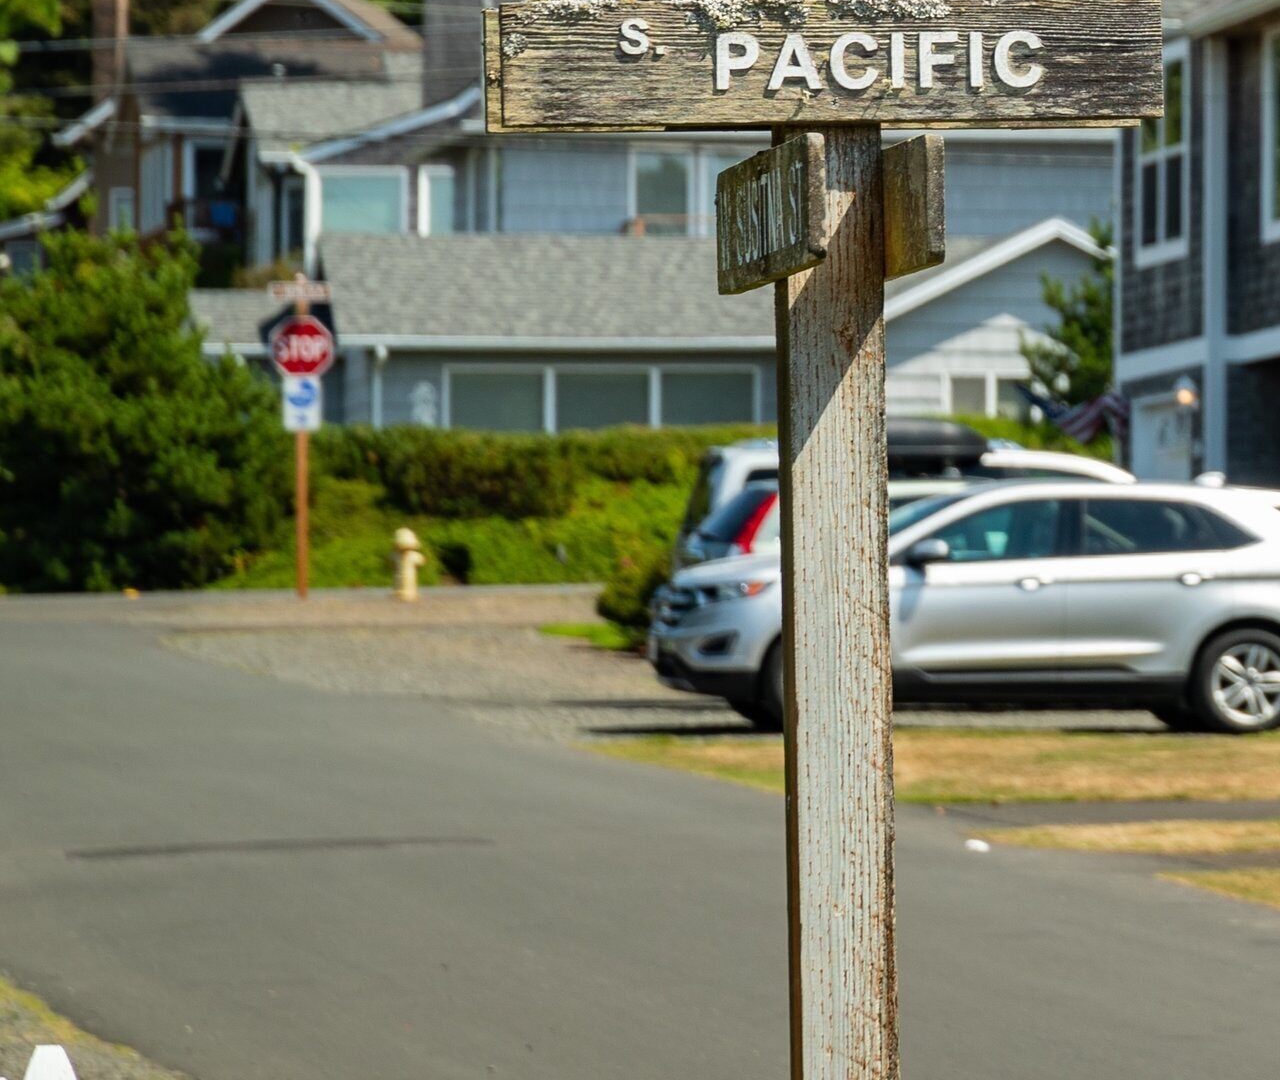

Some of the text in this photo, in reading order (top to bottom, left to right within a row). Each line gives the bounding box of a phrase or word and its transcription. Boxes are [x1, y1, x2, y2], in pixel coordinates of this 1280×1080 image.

[619, 17, 1044, 91] S. PACIFIC
[275, 333, 329, 364] STOP
